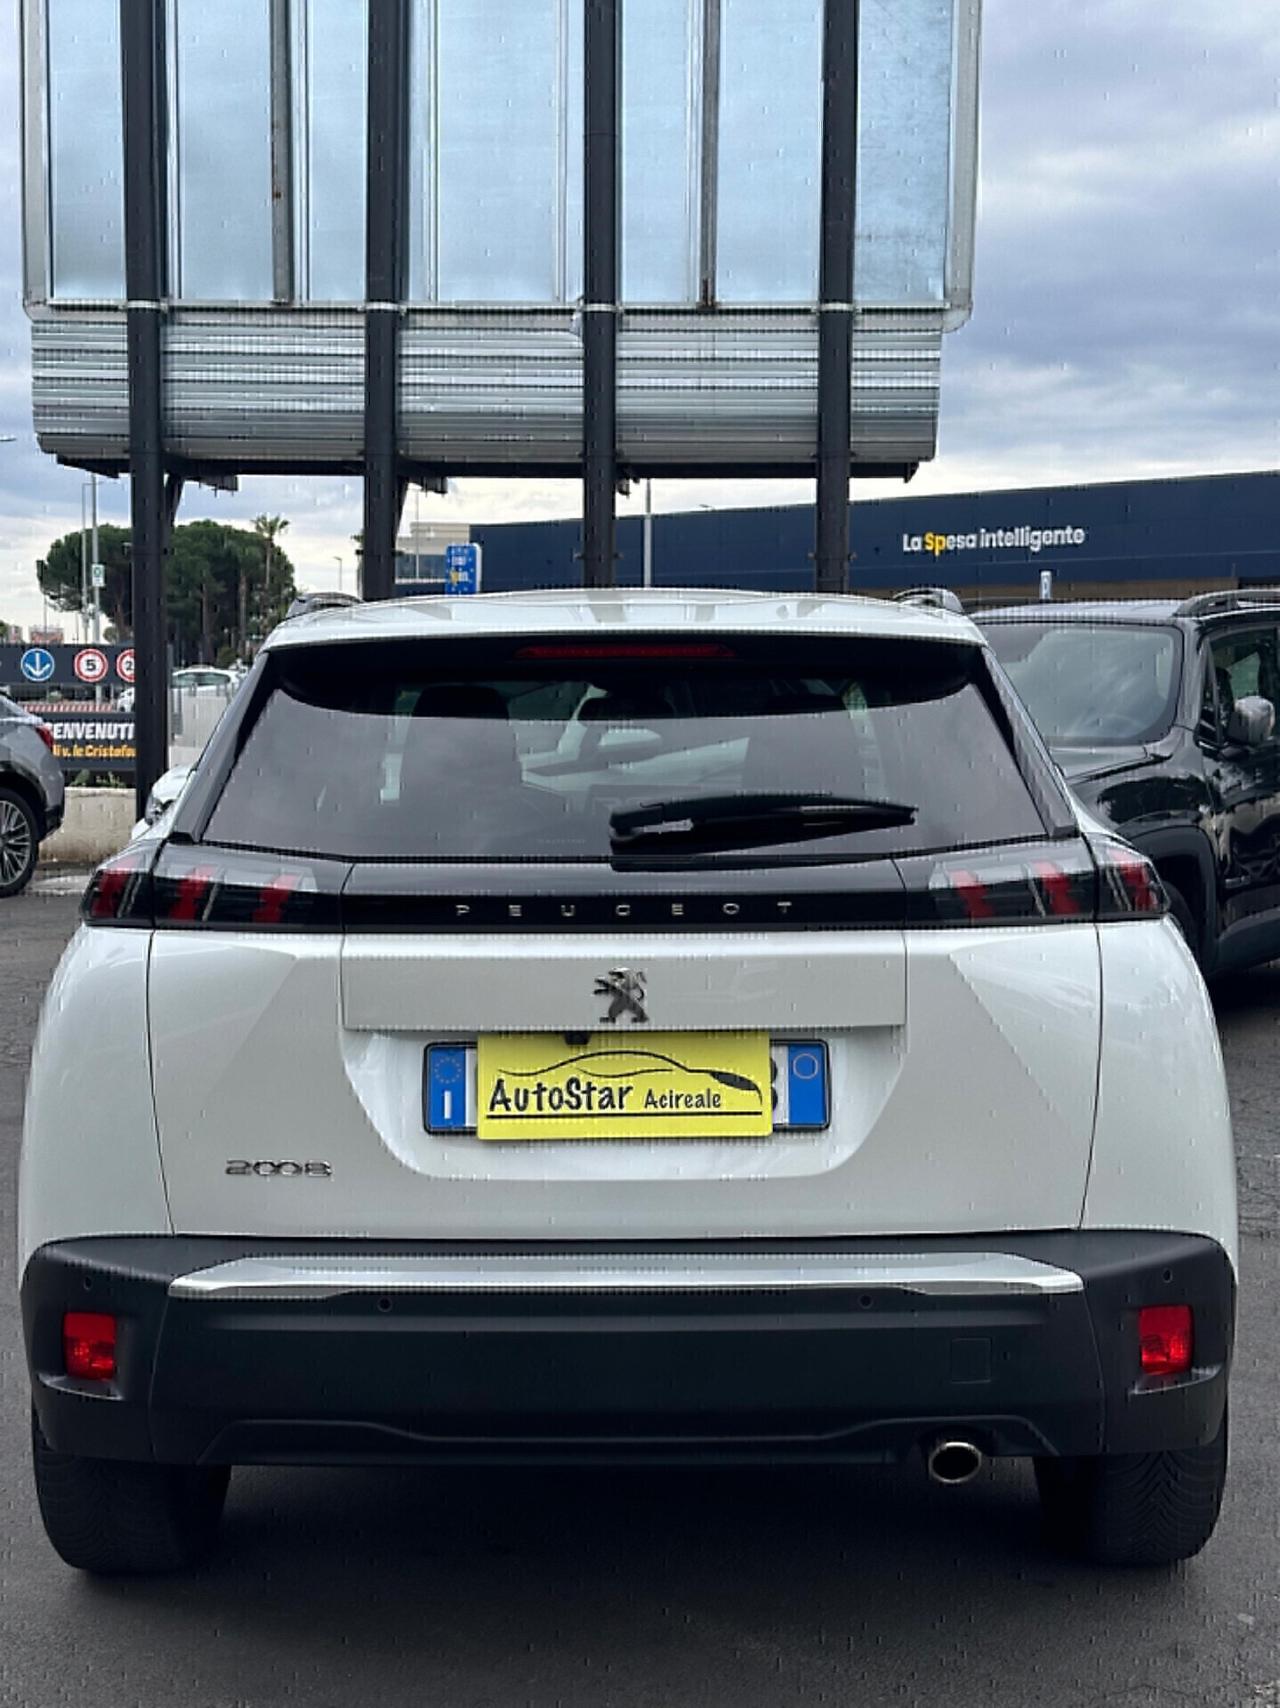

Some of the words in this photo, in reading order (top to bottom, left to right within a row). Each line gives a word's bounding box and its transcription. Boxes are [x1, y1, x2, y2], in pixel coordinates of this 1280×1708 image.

[902, 533, 922, 552] La
[924, 531, 977, 556] Spesa
[980, 525, 1085, 552] intelligente
[86, 659, 97, 671] 5
[455, 901, 793, 918] PEUGEOT
[489, 1076, 634, 1112] AutoStar
[644, 1087, 722, 1110] Acireale
[225, 1159, 333, 1178] 2008
